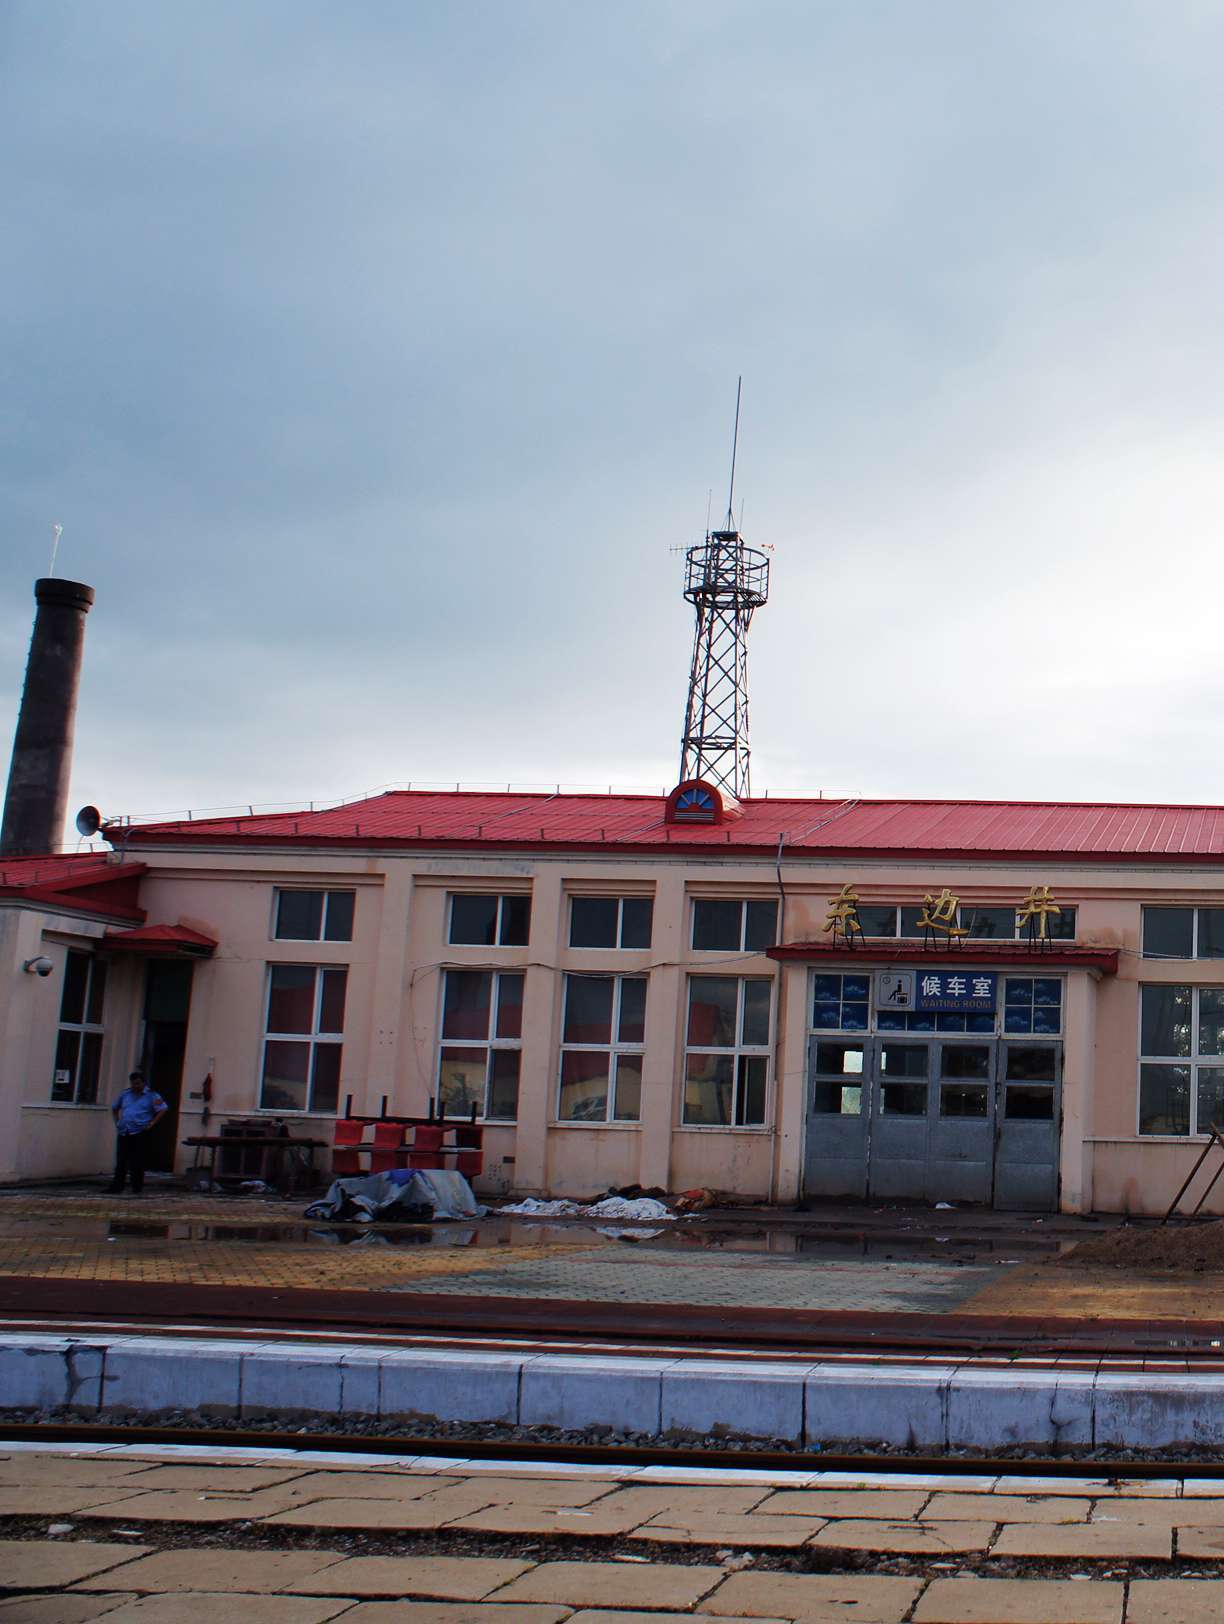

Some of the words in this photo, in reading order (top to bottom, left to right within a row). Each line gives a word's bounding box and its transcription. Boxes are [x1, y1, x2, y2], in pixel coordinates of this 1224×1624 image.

[822, 884, 1062, 939] 东边井
[921, 976, 992, 997] 候车室
[920, 999, 960, 1009] WAITING
[963, 1000, 992, 1009] ROOM
